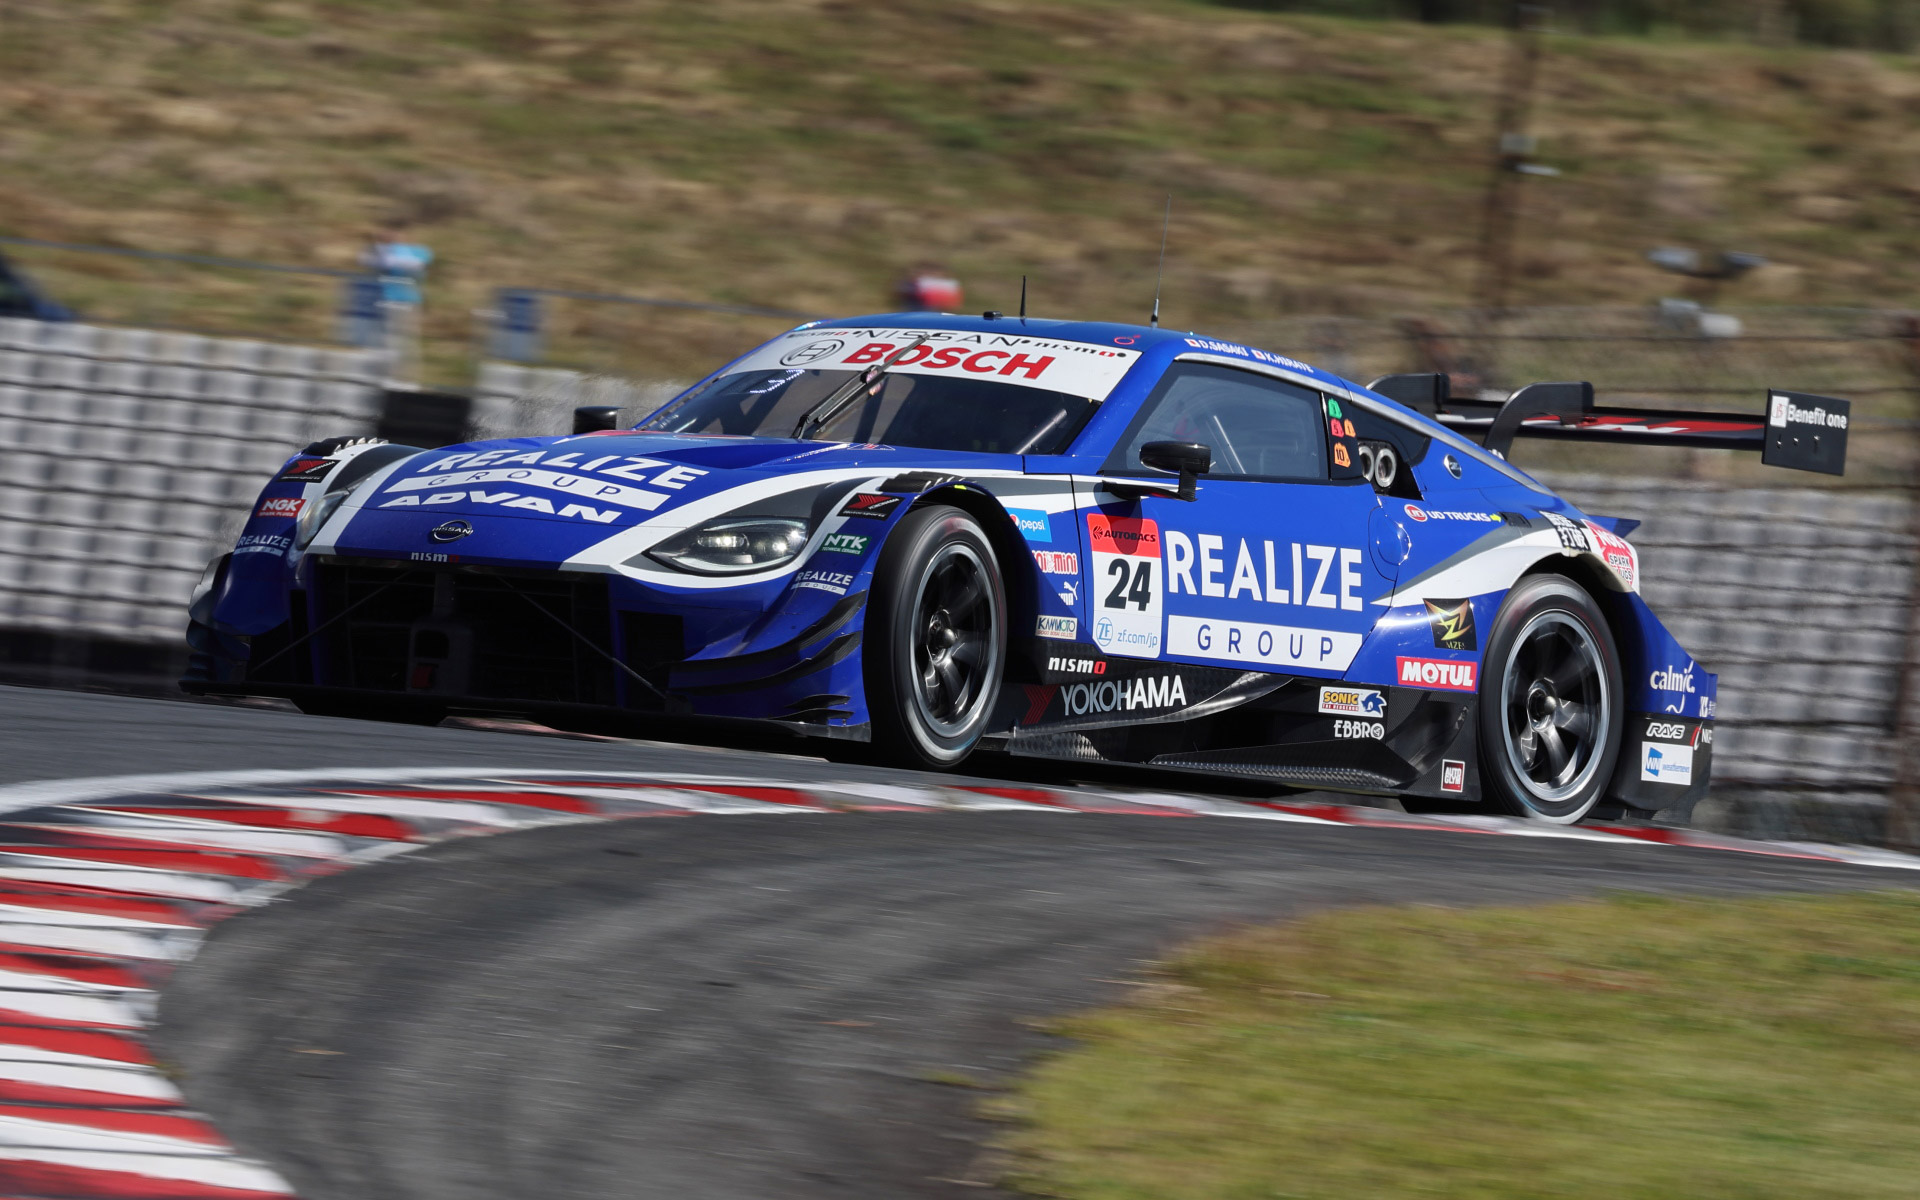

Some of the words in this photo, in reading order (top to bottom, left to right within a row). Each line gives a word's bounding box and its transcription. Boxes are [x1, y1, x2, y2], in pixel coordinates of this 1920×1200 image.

[855, 329, 1021, 346] NISSAN
[1035, 342, 1116, 357] nismo
[841, 342, 1056, 380] BOSCH
[1787, 403, 1826, 426] Benefit
[1826, 413, 1847, 429] one
[417, 449, 710, 490] REALIZE
[427, 470, 623, 497] GROUP
[262, 499, 301, 511] NGK
[378, 490, 623, 524] ADVAN
[1426, 510, 1445, 519] UD
[1443, 511, 1492, 522] TRUCKS
[1021, 519, 1045, 532] pepsi
[238, 535, 291, 548] REALIZE
[824, 535, 867, 550] NTK
[1104, 530, 1156, 543] AUTOBACS
[410, 551, 459, 563] nismo
[1608, 554, 1630, 567] SPARK
[796, 570, 853, 586] REALIZE
[1165, 530, 1363, 612] REALIZE
[1104, 558, 1151, 612] 24
[1098, 623, 1112, 638] ZF
[1117, 629, 1158, 649] zf.com/jp
[1197, 624, 1333, 662] GROUP
[1048, 657, 1107, 675] nismo
[1402, 661, 1473, 687] MOTUL
[1650, 661, 1695, 693] calmic
[1060, 675, 1187, 716] YOKOHAMA
[1323, 691, 1359, 705] SONIC
[1333, 719, 1385, 740] EBBRO
[1646, 722, 1685, 739] RAYS
